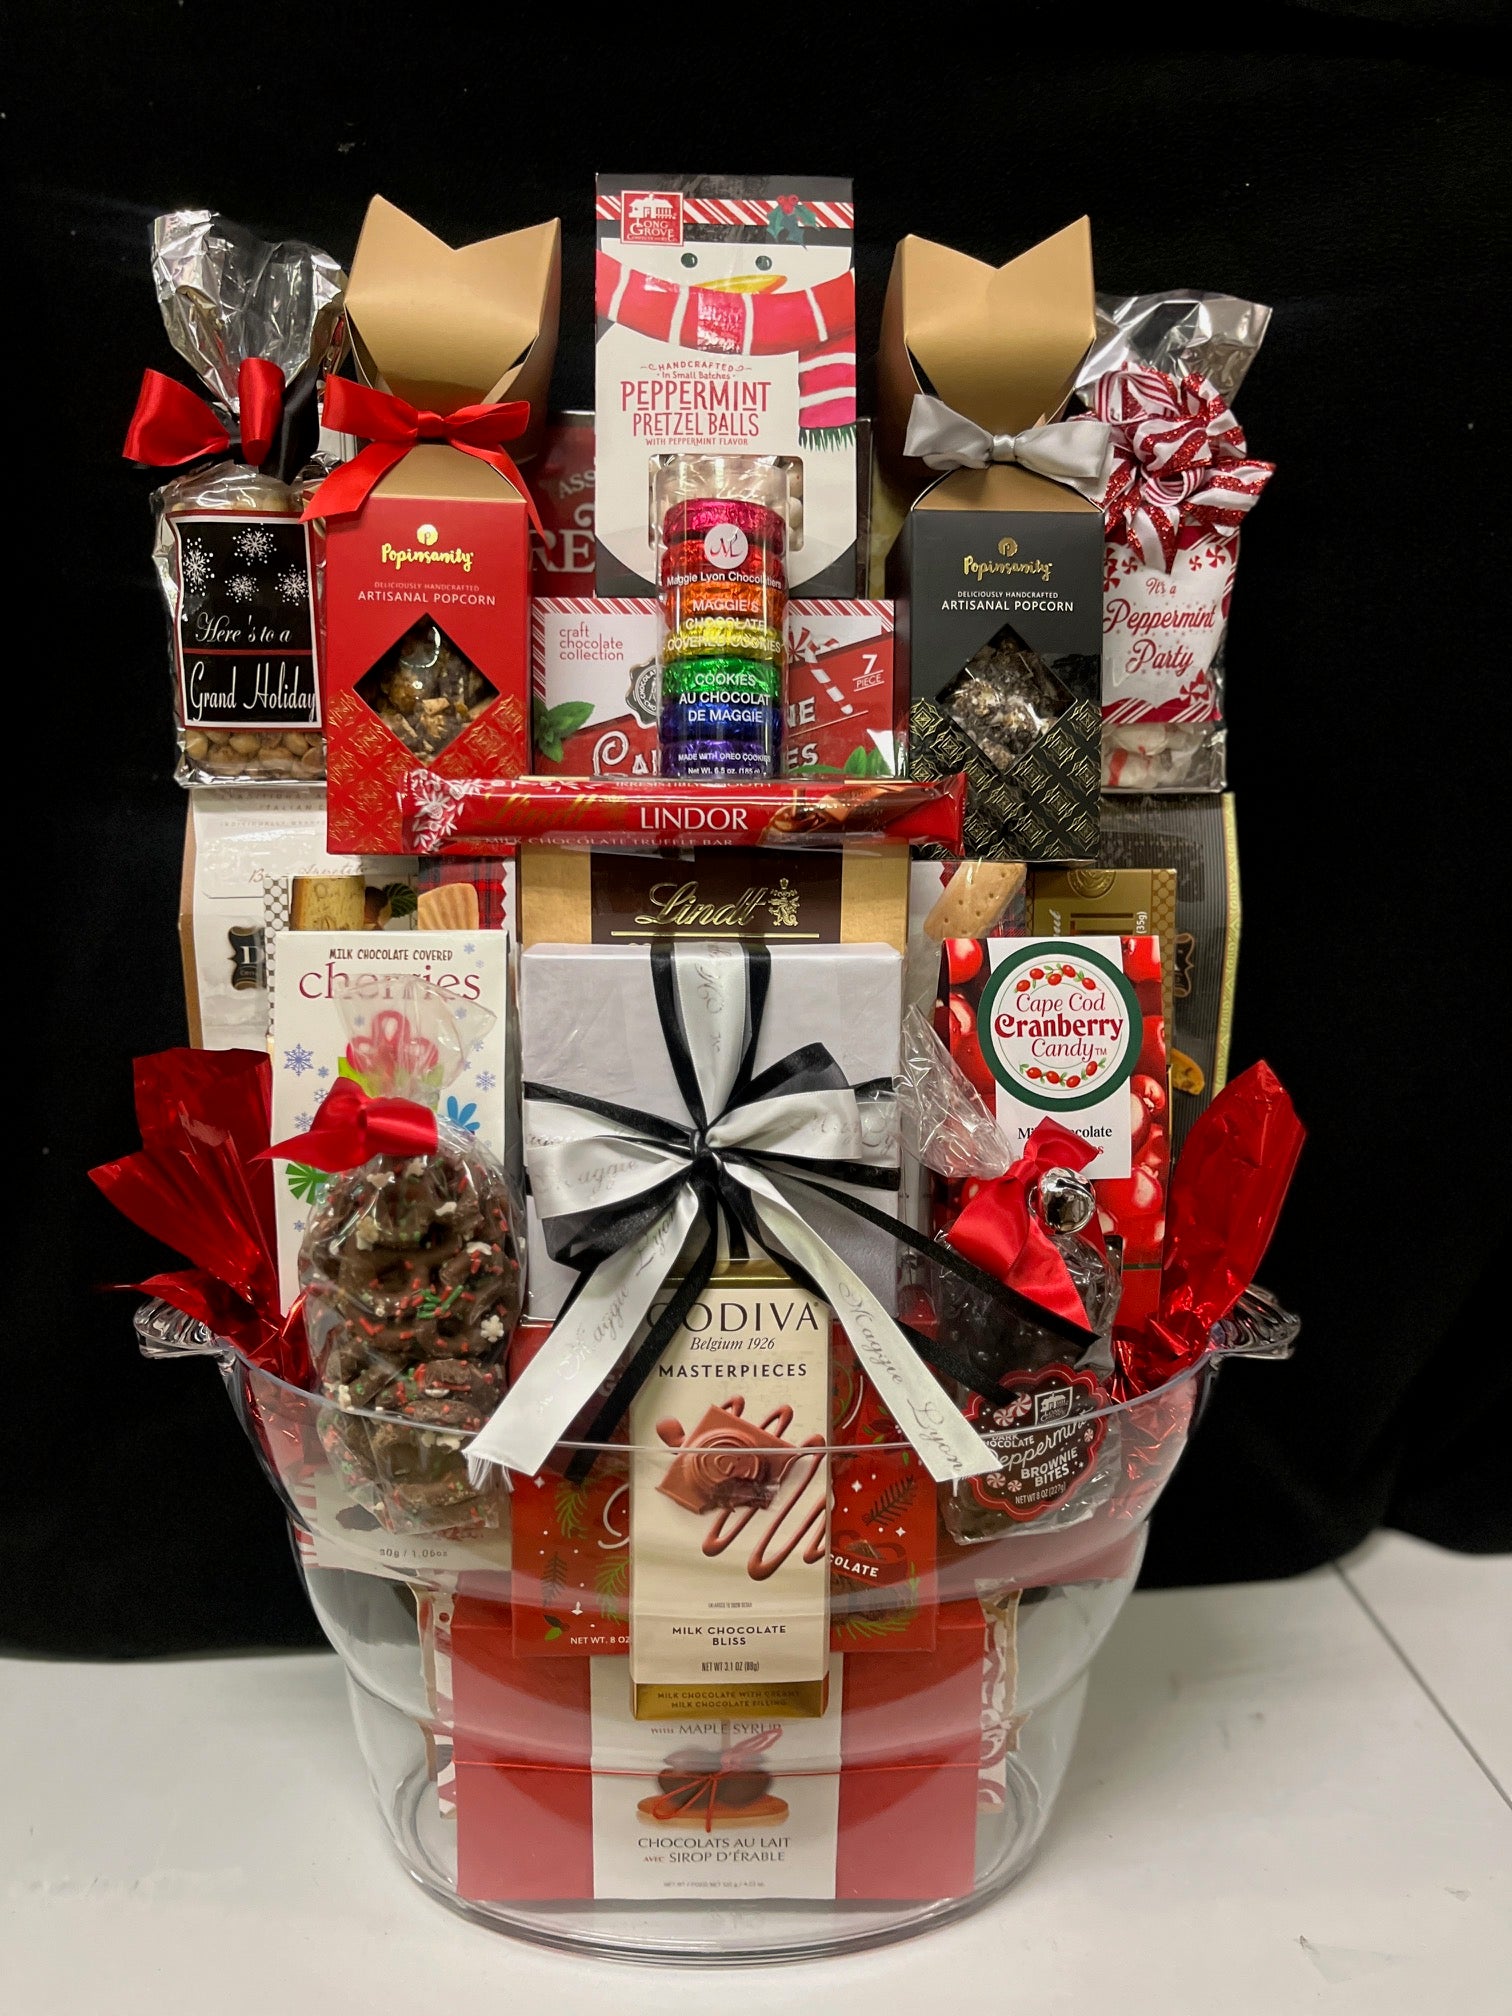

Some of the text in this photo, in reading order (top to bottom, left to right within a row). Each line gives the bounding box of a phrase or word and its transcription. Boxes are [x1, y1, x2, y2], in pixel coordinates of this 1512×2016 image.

[635, 217, 669, 229] LONG
[629, 223, 675, 240] GROVE
[658, 361, 735, 372] HANDCRAFTED
[699, 372, 731, 380] Batches
[620, 380, 772, 412] PEPPERMINT
[633, 412, 760, 437] PRETZEL BALLS
[645, 437, 749, 446] WITH PEPPERMINT FLAVOR
[381, 543, 474, 573] Popinsanity
[963, 555, 1054, 582] Popinsanity
[374, 581, 480, 592] DELICIOUSLY HANDCRAFTED
[666, 571, 782, 589] Maggie Lyon Chocoltiers
[957, 591, 1059, 599] DELICIOUSLY HANDCRAFTED
[1169, 583, 1177, 595] a
[358, 591, 496, 606] ARTISANAL POPCORN
[692, 599, 760, 613] MAGGIE'S
[941, 600, 1074, 612] ARTISANAL POPCORN
[1103, 598, 1218, 636] Peppermint
[260, 625, 274, 643] to
[279, 628, 292, 643] a
[559, 621, 590, 640] craft
[559, 633, 625, 651] chocolate
[559, 648, 625, 661] collection
[1125, 638, 1195, 678] Party
[861, 654, 878, 675] 7
[694, 673, 757, 687] COOKIES
[856, 673, 882, 688] PIECE
[190, 660, 317, 723] Grand Holiday
[679, 691, 771, 706] AU CHOCOLAT
[688, 709, 764, 723] DE MAGGIE
[678, 753, 698, 762] MADE
[719, 752, 742, 761] OREO
[640, 806, 749, 830] LINDOR
[527, 836, 624, 847] CHOCOLATE
[633, 837, 695, 846] TRUFFLE
[702, 838, 733, 846] BAR
[634, 880, 769, 926] Lindt
[1135, 911, 1148, 935] (35g)
[329, 949, 453, 961] MILK CHOCOLATE COVERED
[1016, 992, 1106, 1017] Cape Cod
[994, 1013, 1124, 1041] Cranberry
[1031, 1037, 1095, 1063] Candy
[690, 1337, 775, 1352] Belgium 1926
[658, 1363, 808, 1378] MASTERPIECES
[838, 1281, 964, 1473] Maggie Lyon
[1021, 1447, 1078, 1480] BROWNIE
[1034, 1463, 1070, 1487] BITES
[1015, 1494, 1027, 1504] NET
[1040, 1488, 1049, 1498] OZ
[672, 1625, 787, 1636] MILK CHOCOLATE
[570, 1637, 588, 1645] NET
[590, 1636, 608, 1645] WT.
[712, 1637, 747, 1646] BLISS
[701, 1661, 713, 1672] NET
[713, 1661, 724, 1671] WT
[735, 1661, 743, 1671] OZ
[658, 1691, 679, 1699] MILK
[682, 1690, 736, 1699] CHOCOLATE
[739, 1690, 762, 1698] WITH
[695, 1700, 750, 1708] CHOCOLATE
[678, 1723, 730, 1735] MAPLE
[637, 1837, 791, 1849] CHOCOLATS AU LAIT
[669, 1851, 713, 1863] SIROP
